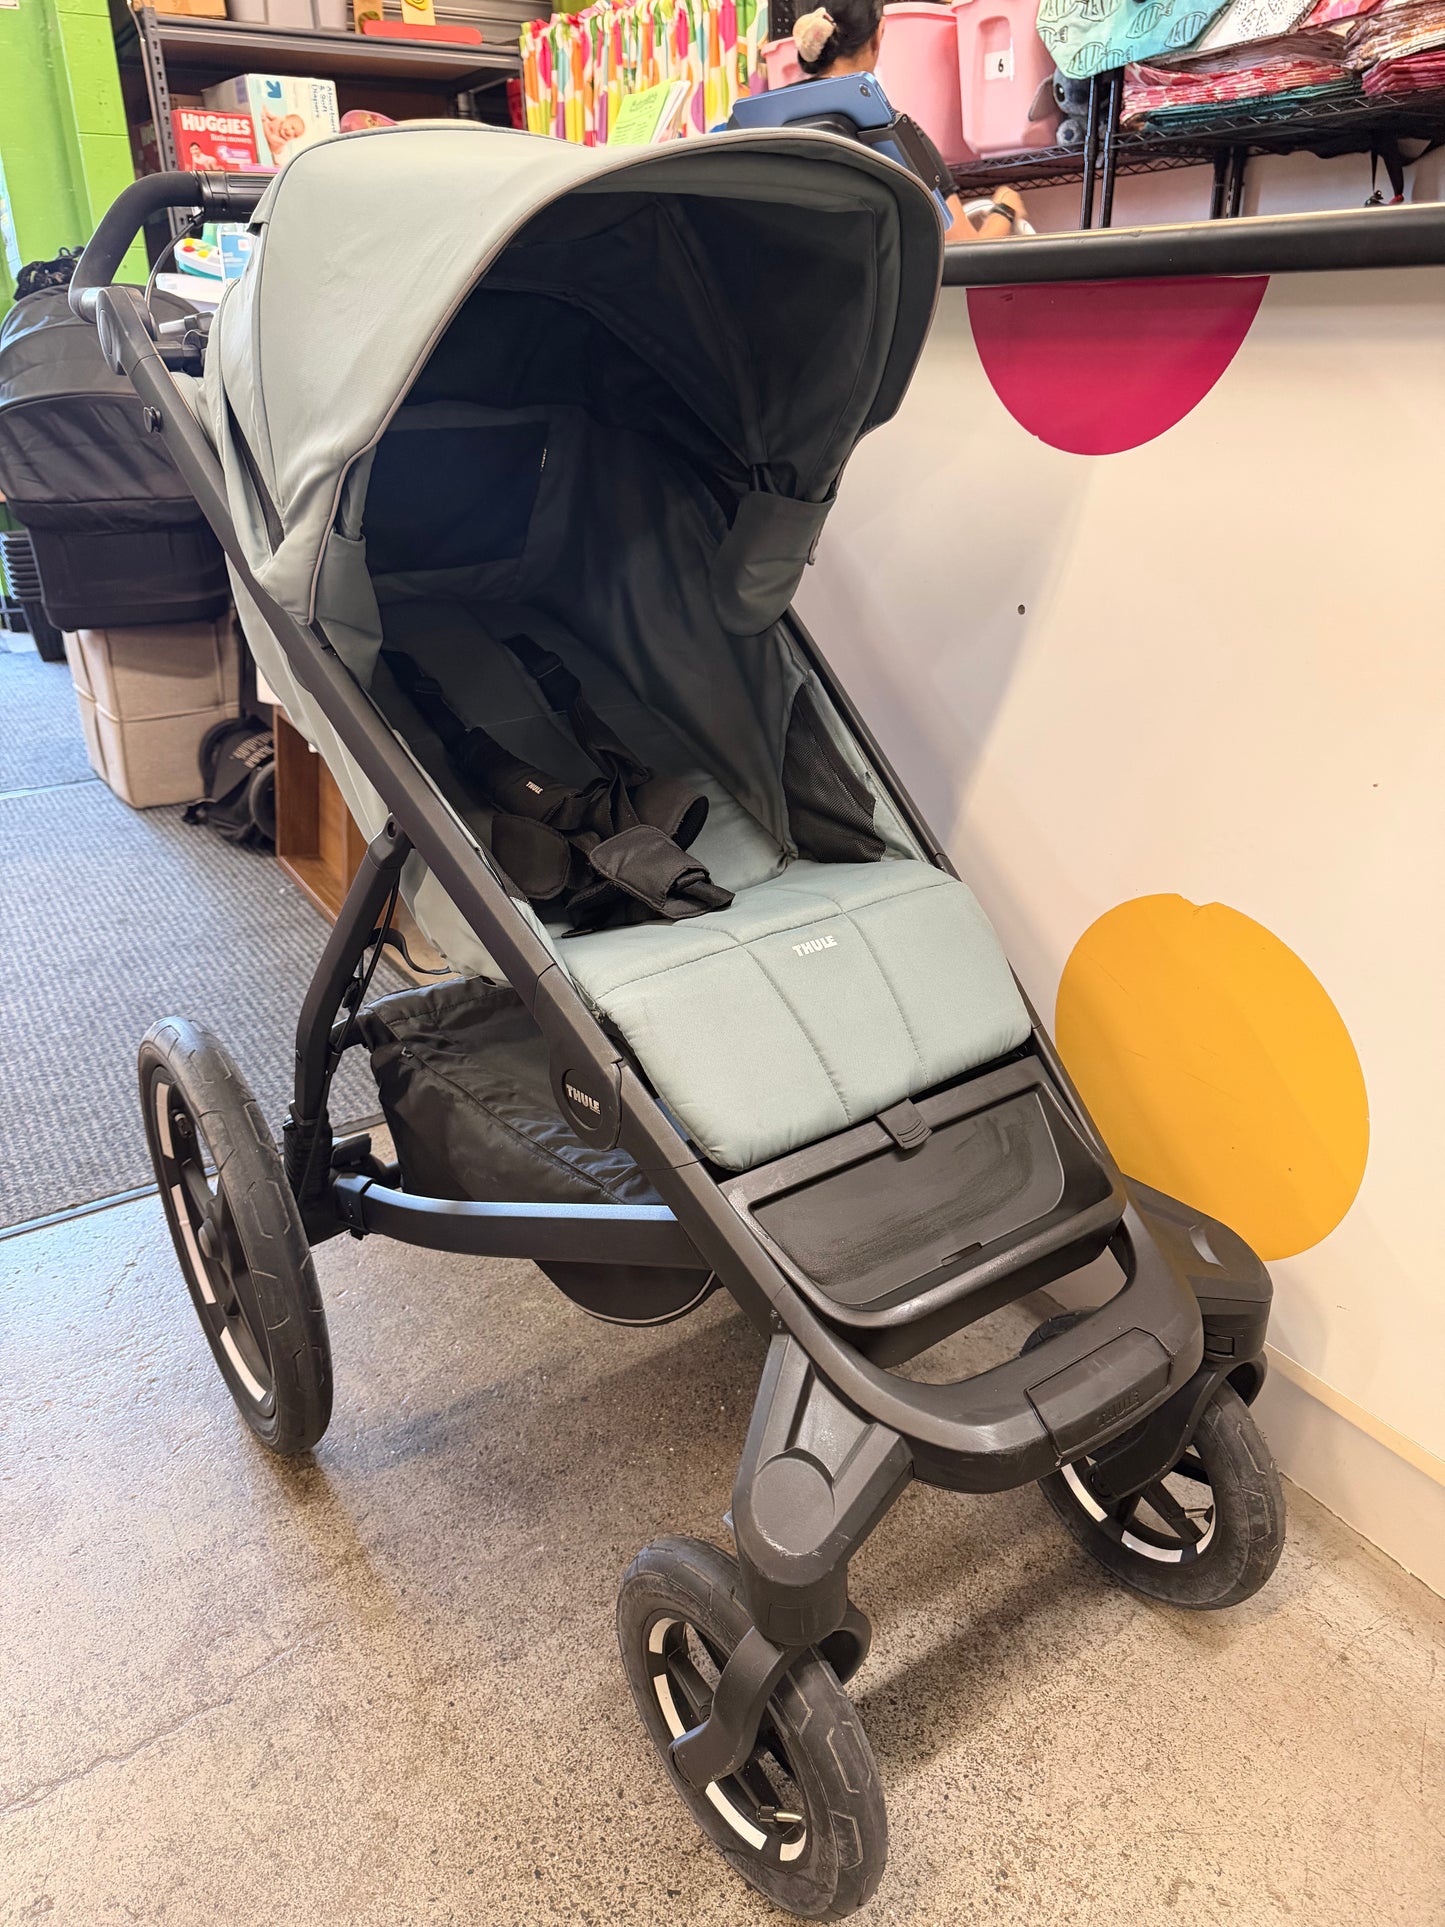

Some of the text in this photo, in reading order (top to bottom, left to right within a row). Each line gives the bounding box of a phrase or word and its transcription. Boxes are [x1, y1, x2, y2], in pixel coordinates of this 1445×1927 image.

[998, 58, 1004, 73] 6
[180, 113, 251, 135] HUGGIES
[525, 781, 544, 794] THULE
[791, 935, 838, 957] THULE
[566, 1083, 601, 1115] THULE
